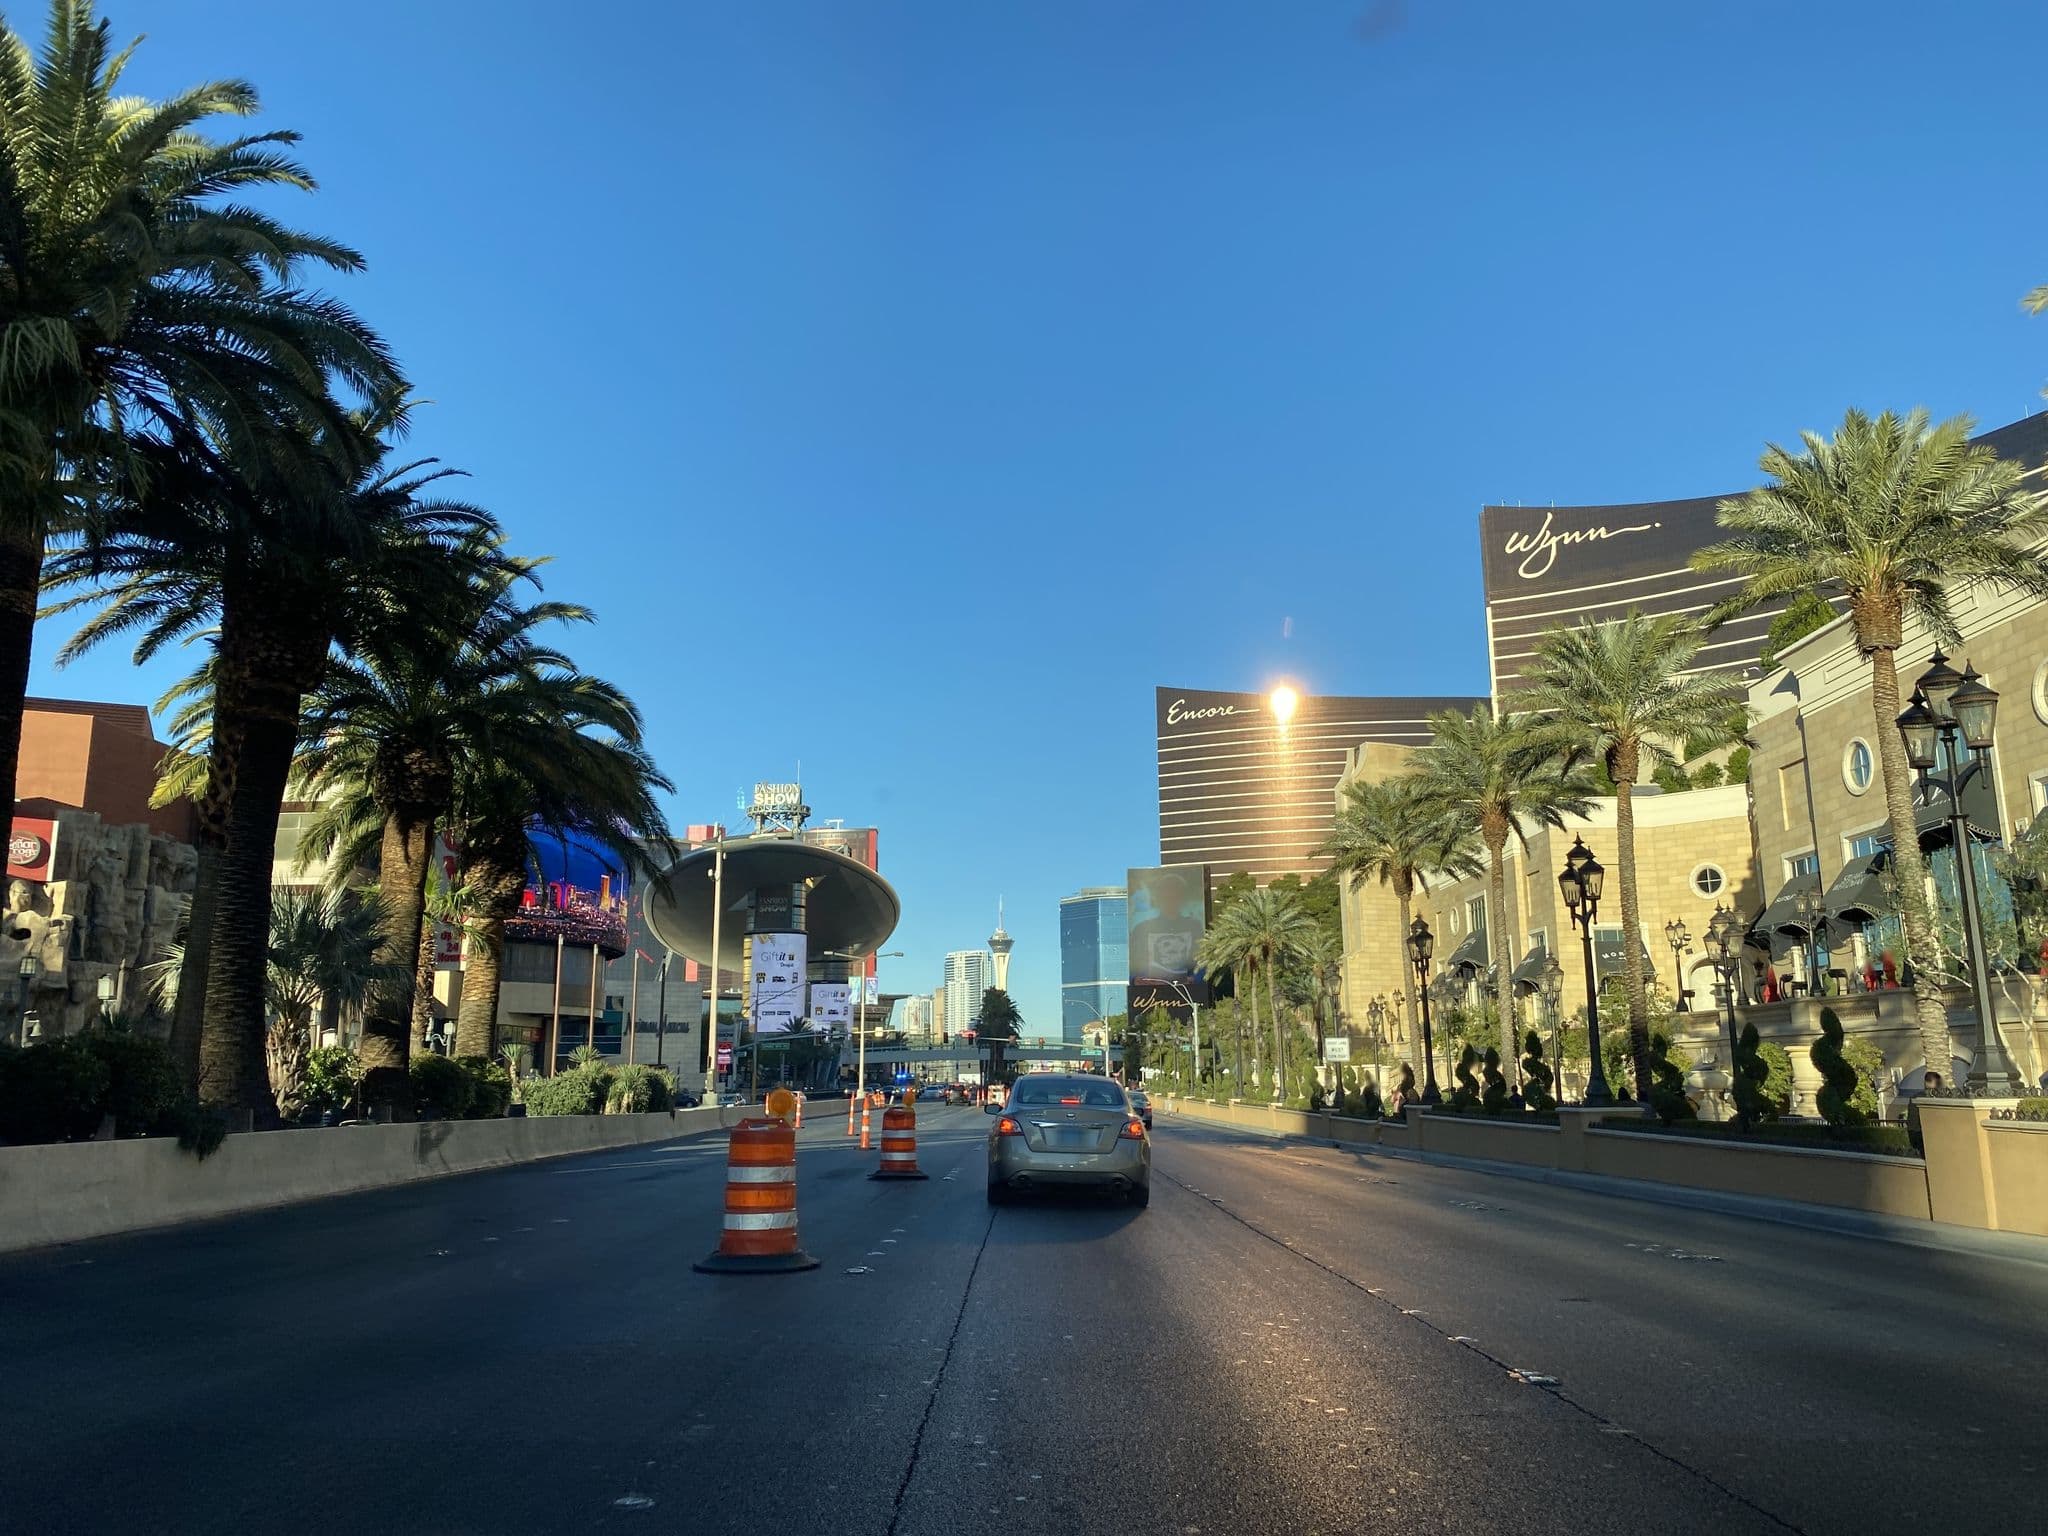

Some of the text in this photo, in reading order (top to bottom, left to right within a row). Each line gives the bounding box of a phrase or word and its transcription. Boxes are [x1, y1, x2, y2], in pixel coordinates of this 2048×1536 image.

[1505, 512, 1652, 579] Wynn
[1166, 699, 1260, 725] Encore
[754, 783, 800, 793] FASHION
[754, 793, 800, 805] SHOW
[1132, 988, 1192, 1016] Wynn
